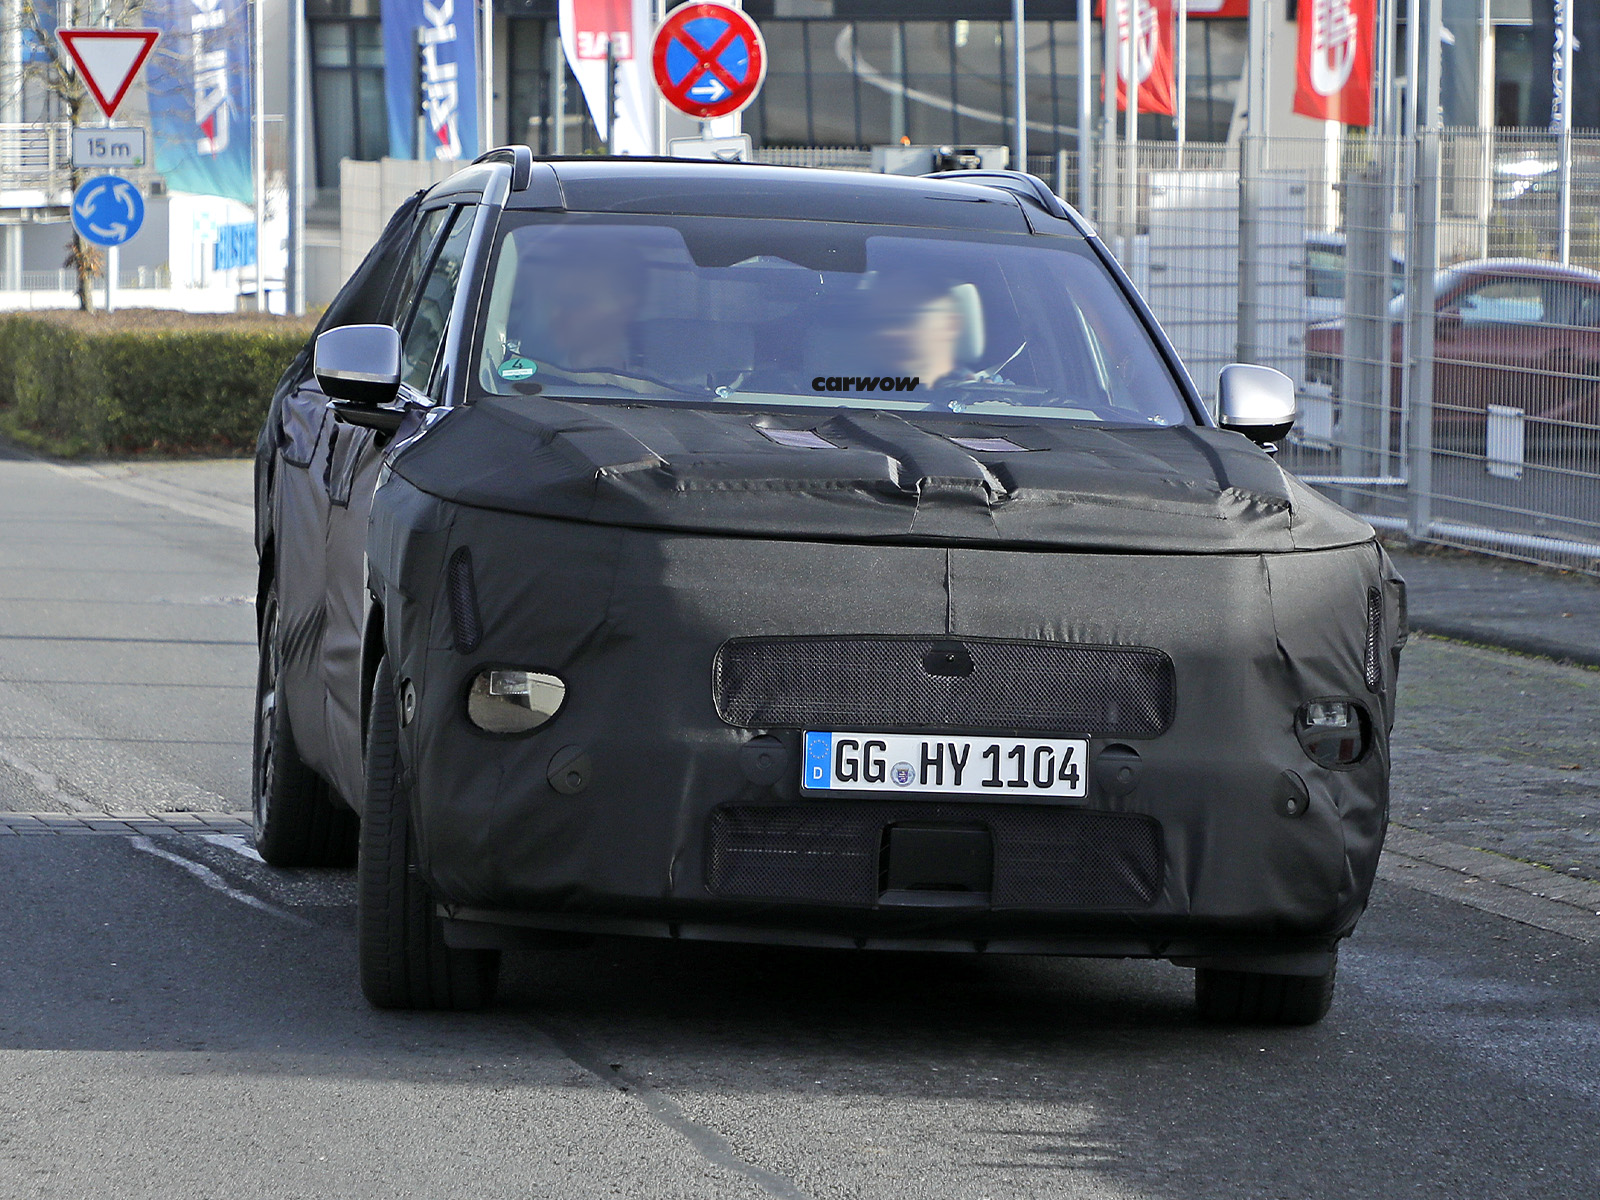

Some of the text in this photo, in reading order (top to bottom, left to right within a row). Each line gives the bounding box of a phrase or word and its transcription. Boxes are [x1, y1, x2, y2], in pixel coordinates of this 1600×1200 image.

[88, 138, 130, 157] 15 m
[512, 358, 523, 369] 4
[835, 740, 1080, 790] GG HY 1104
[813, 767, 823, 780] D
